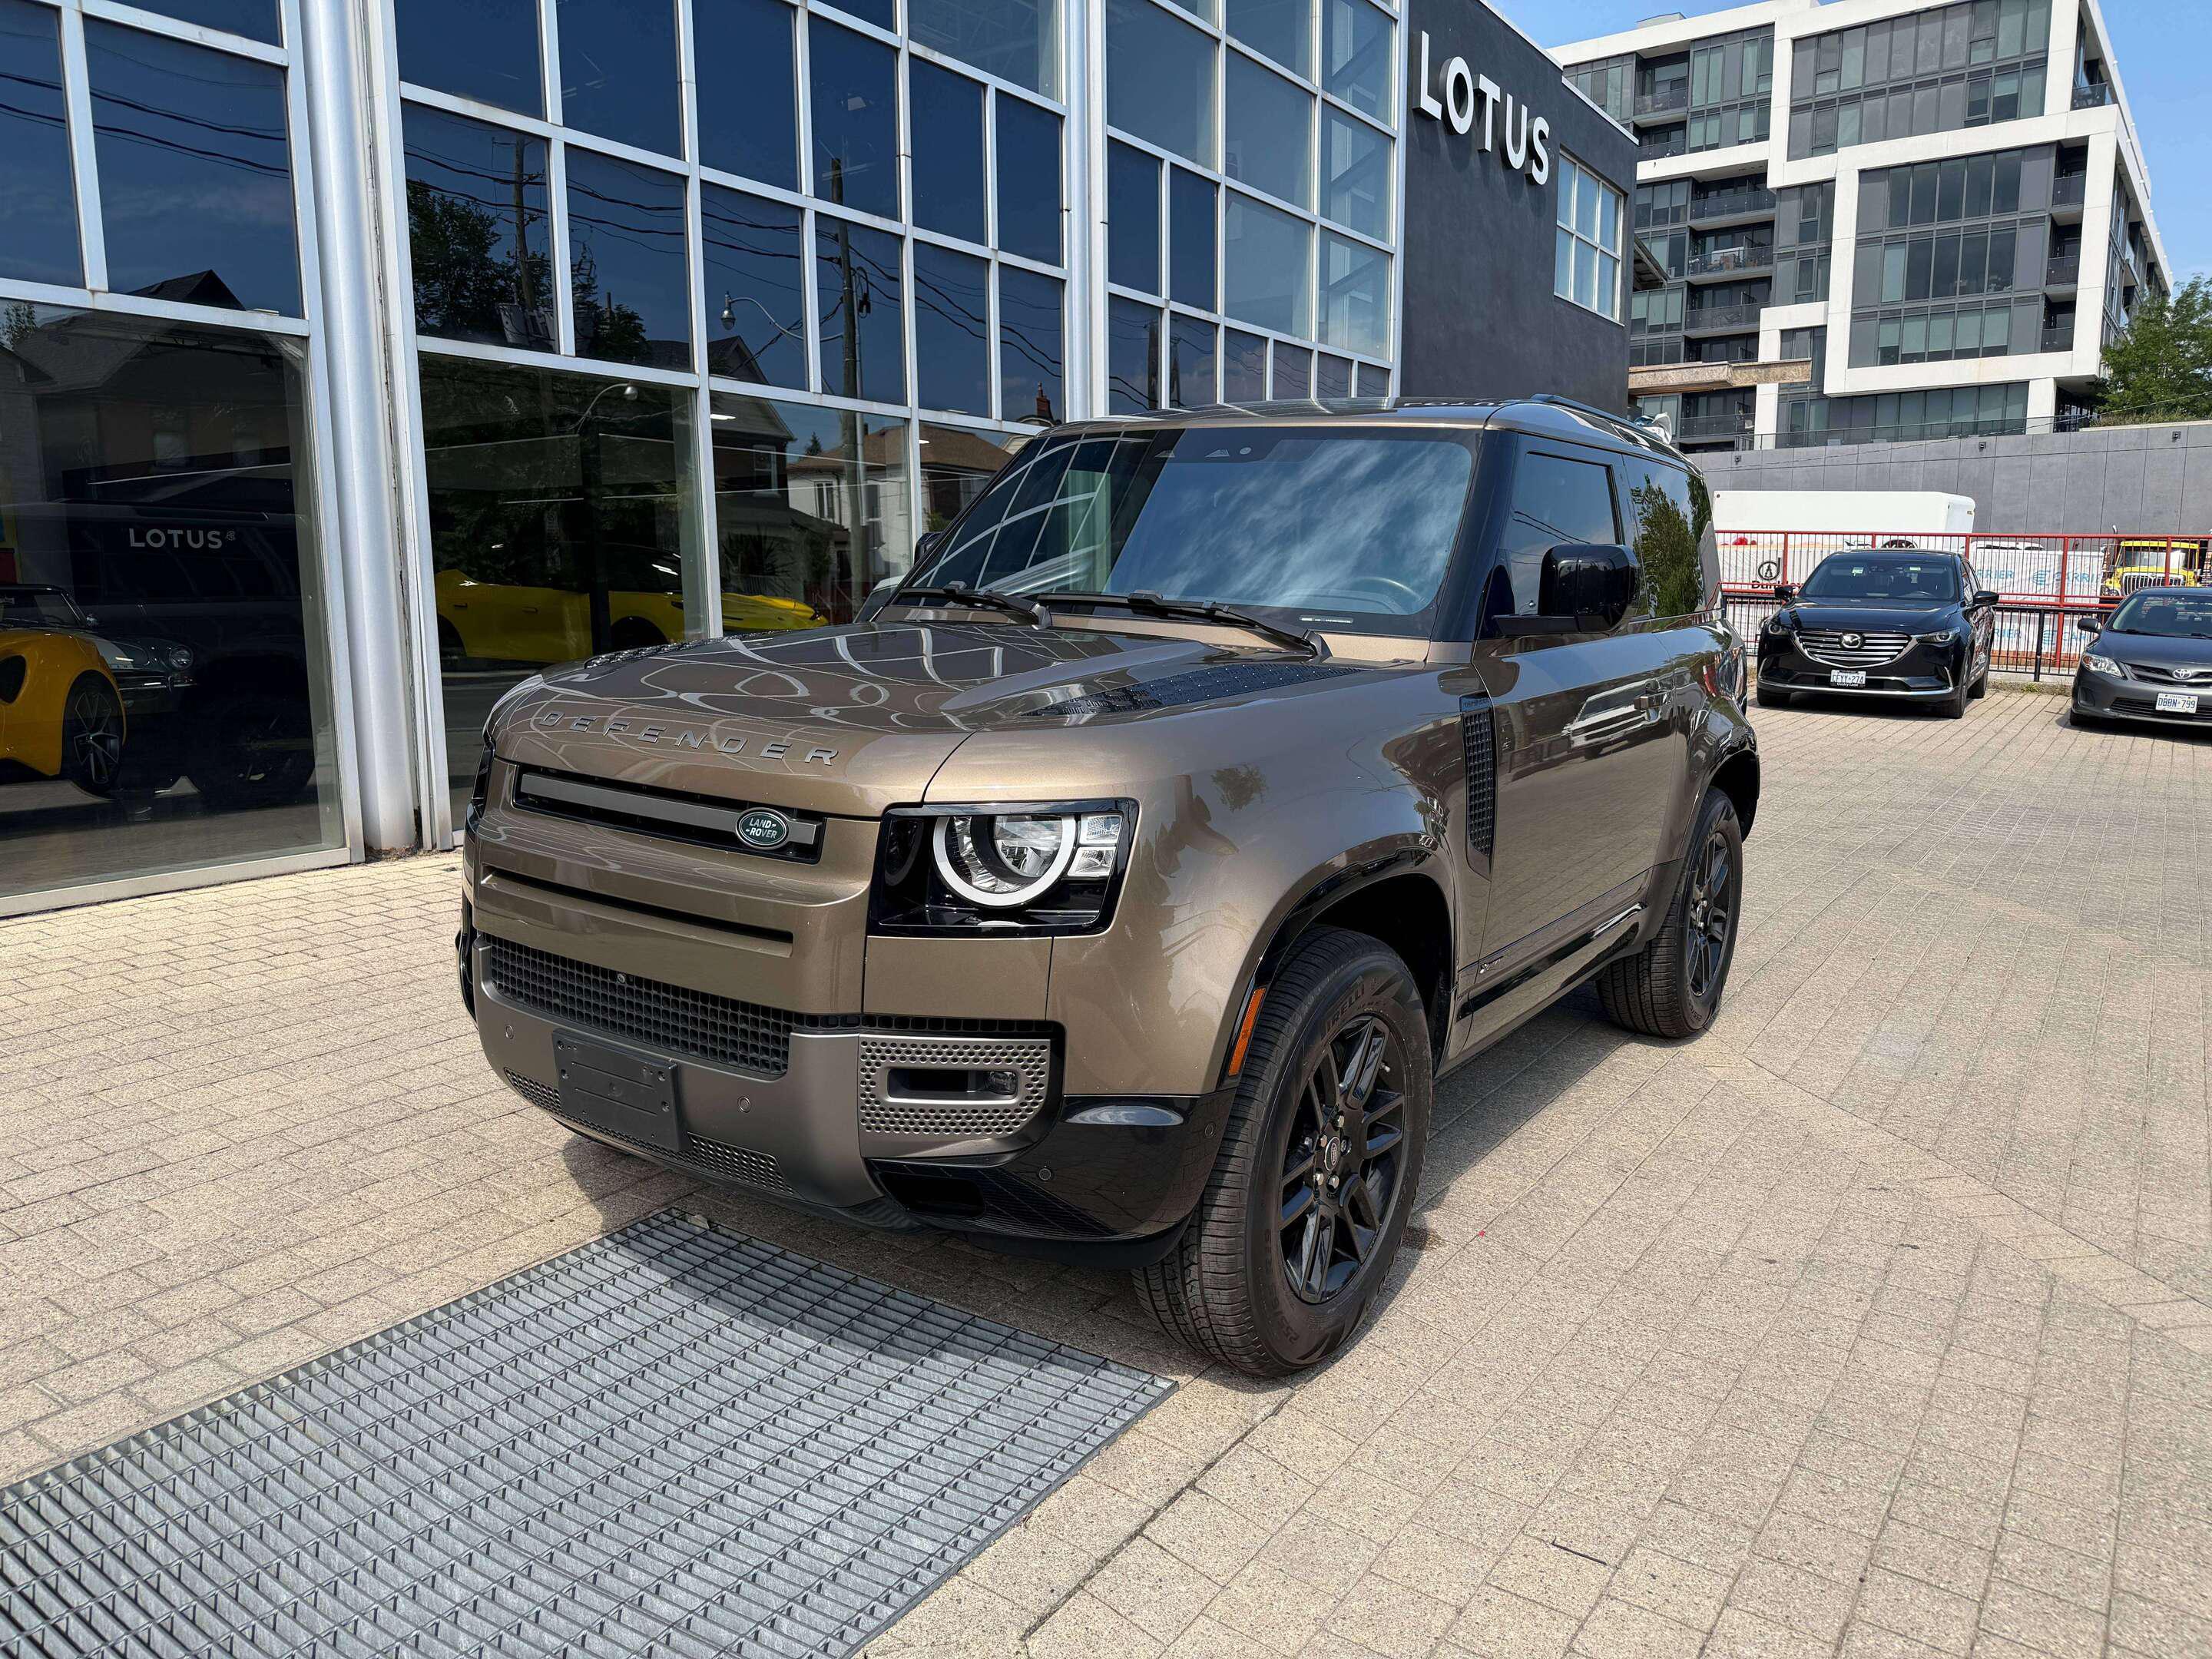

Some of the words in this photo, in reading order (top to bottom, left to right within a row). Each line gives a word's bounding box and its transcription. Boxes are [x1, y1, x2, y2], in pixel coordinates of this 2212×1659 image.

[1420, 29, 1550, 186] LOTUS
[128, 528, 223, 549] LOTUS
[2181, 699, 2196, 709] 799
[539, 711, 839, 767] DEFENDER
[749, 817, 772, 829] LAND
[749, 827, 777, 839] ROVER
